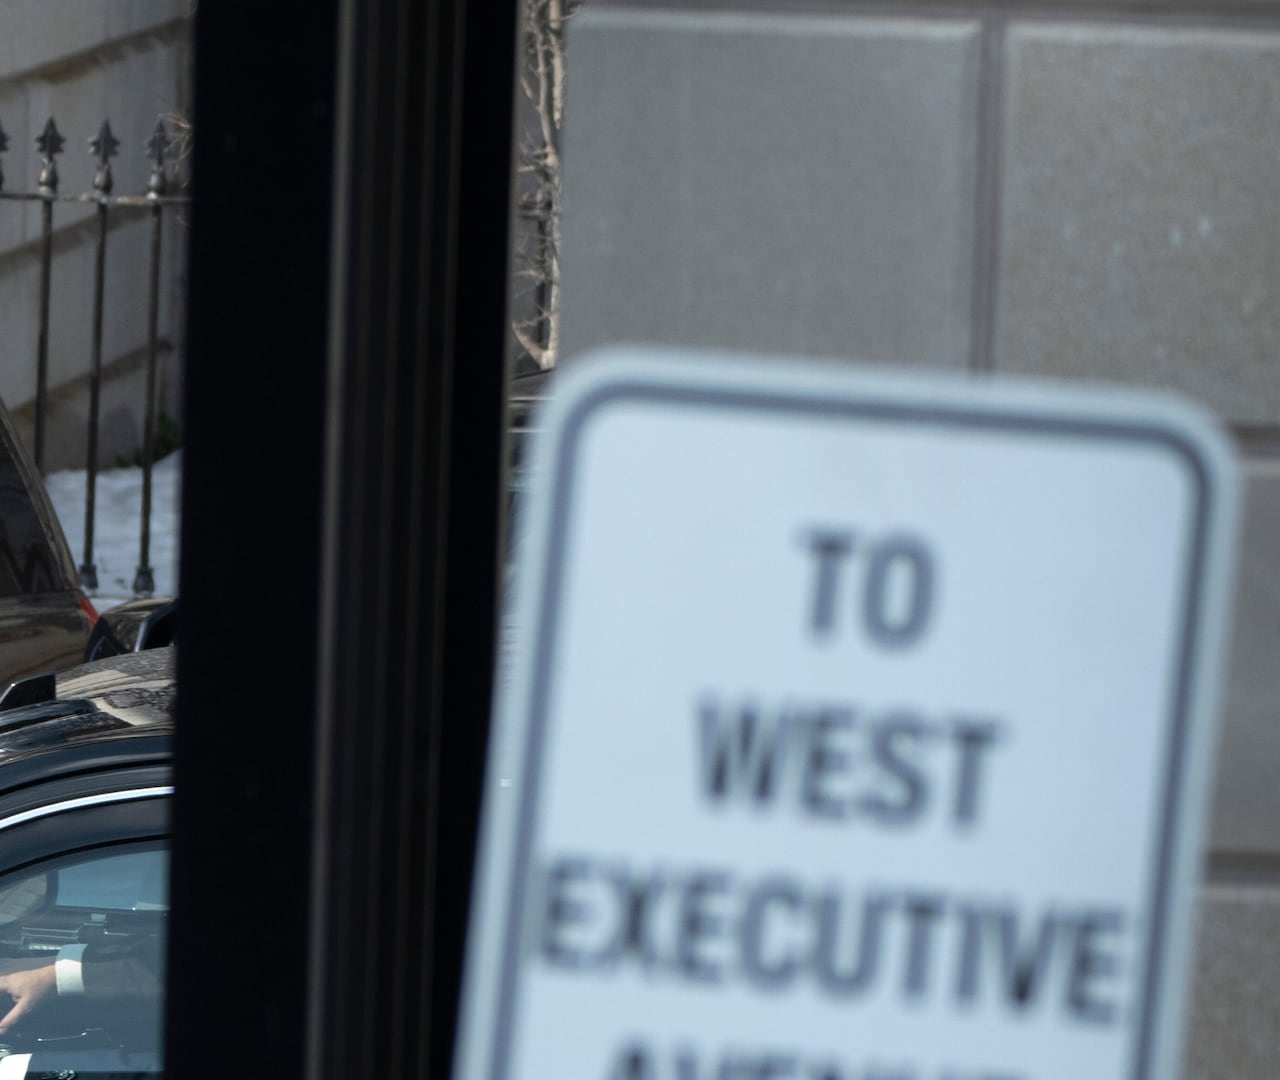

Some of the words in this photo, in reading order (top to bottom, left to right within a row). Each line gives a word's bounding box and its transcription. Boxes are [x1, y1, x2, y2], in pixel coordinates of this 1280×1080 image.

[798, 525, 939, 652] TO
[695, 692, 1003, 833] WEST
[533, 856, 1134, 1027] EXECUTIVE
